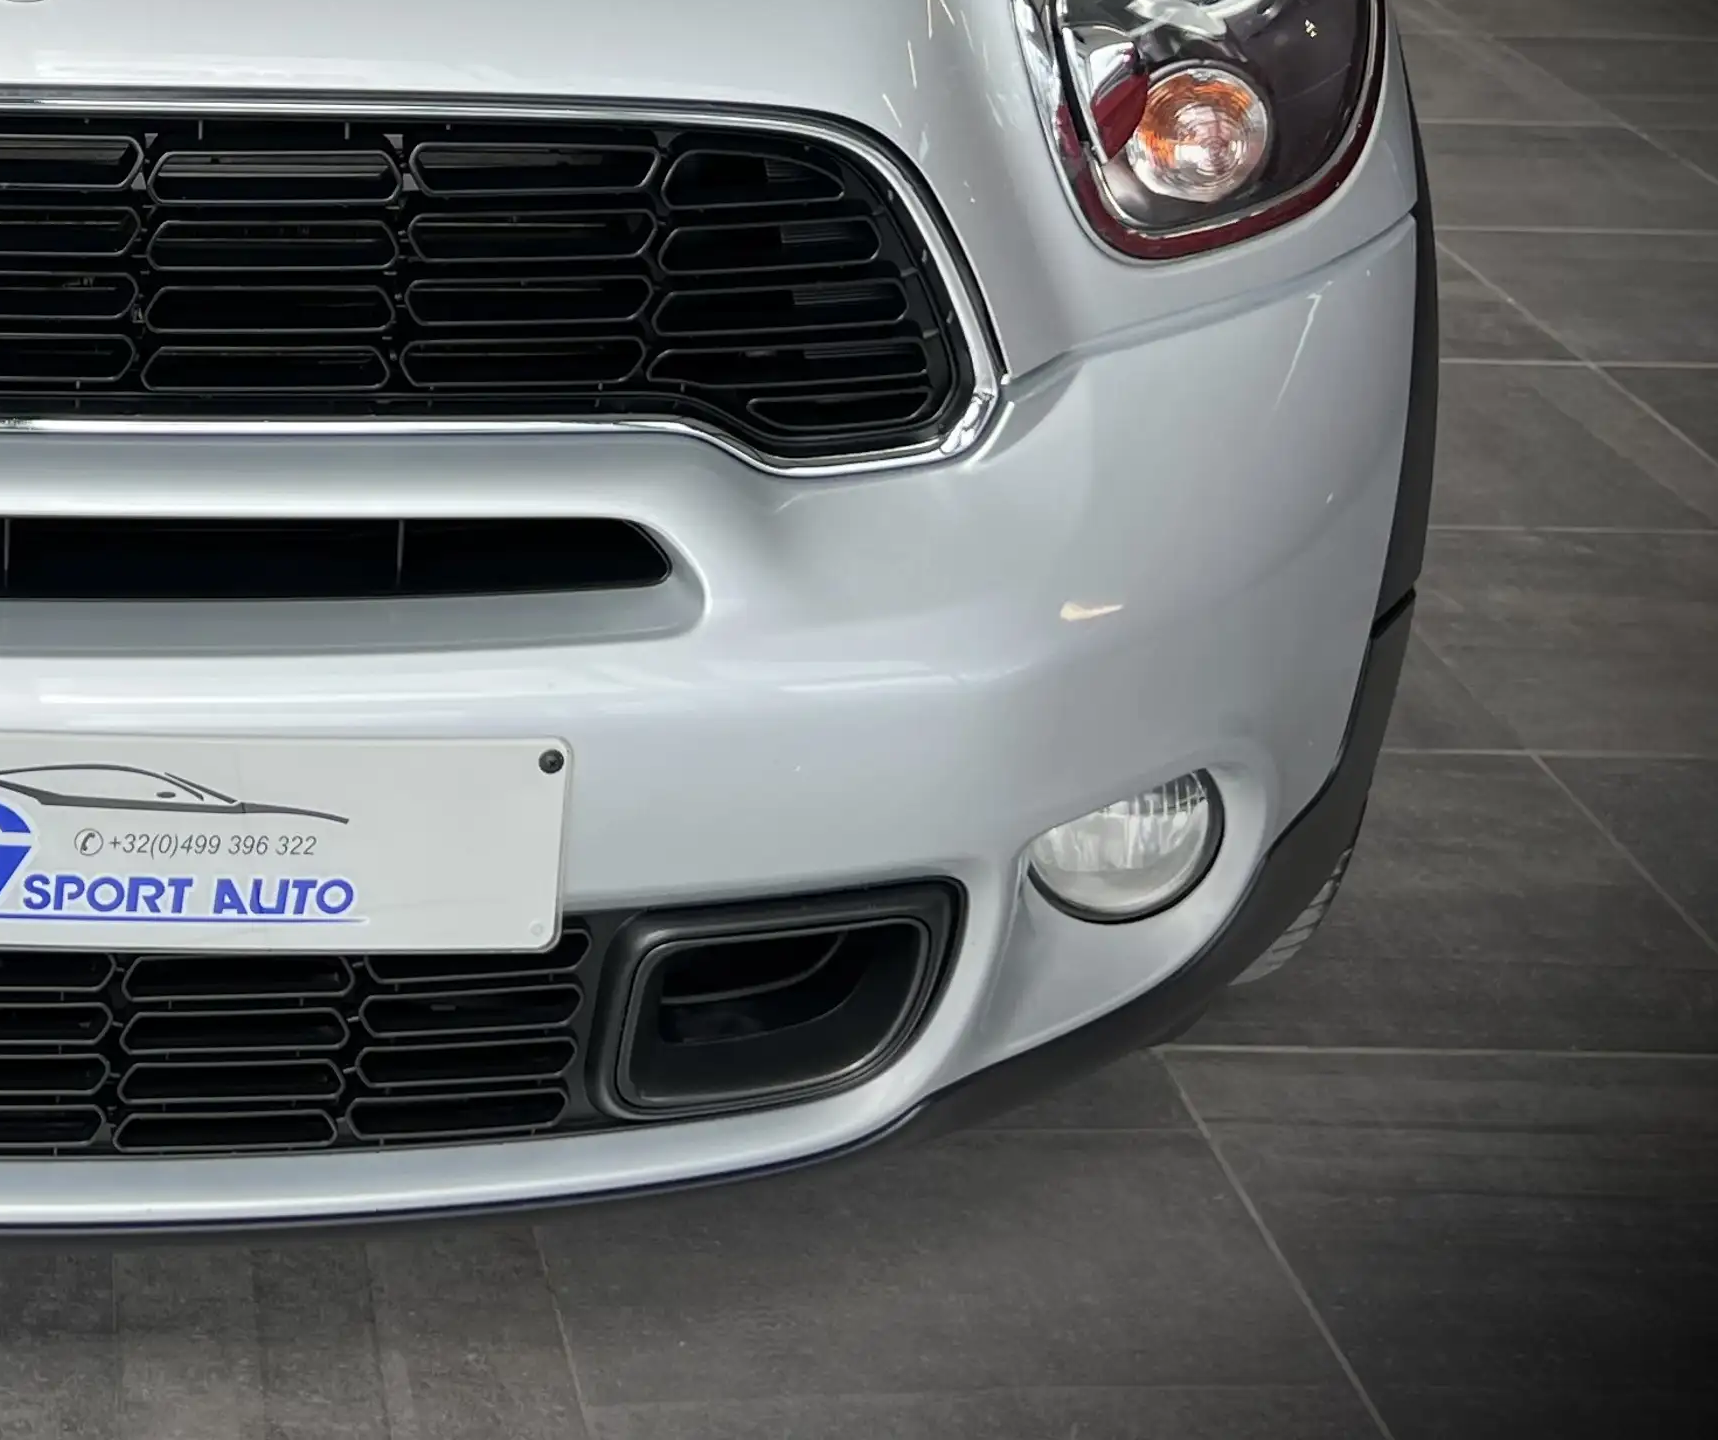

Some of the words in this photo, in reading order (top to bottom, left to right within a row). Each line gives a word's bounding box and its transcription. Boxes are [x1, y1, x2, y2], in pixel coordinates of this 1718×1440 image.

[108, 832, 221, 859] +32(0)499
[227, 835, 268, 857] 396
[275, 835, 317, 857] 322
[23, 874, 193, 914] SPORT
[213, 879, 354, 915] AUTO
